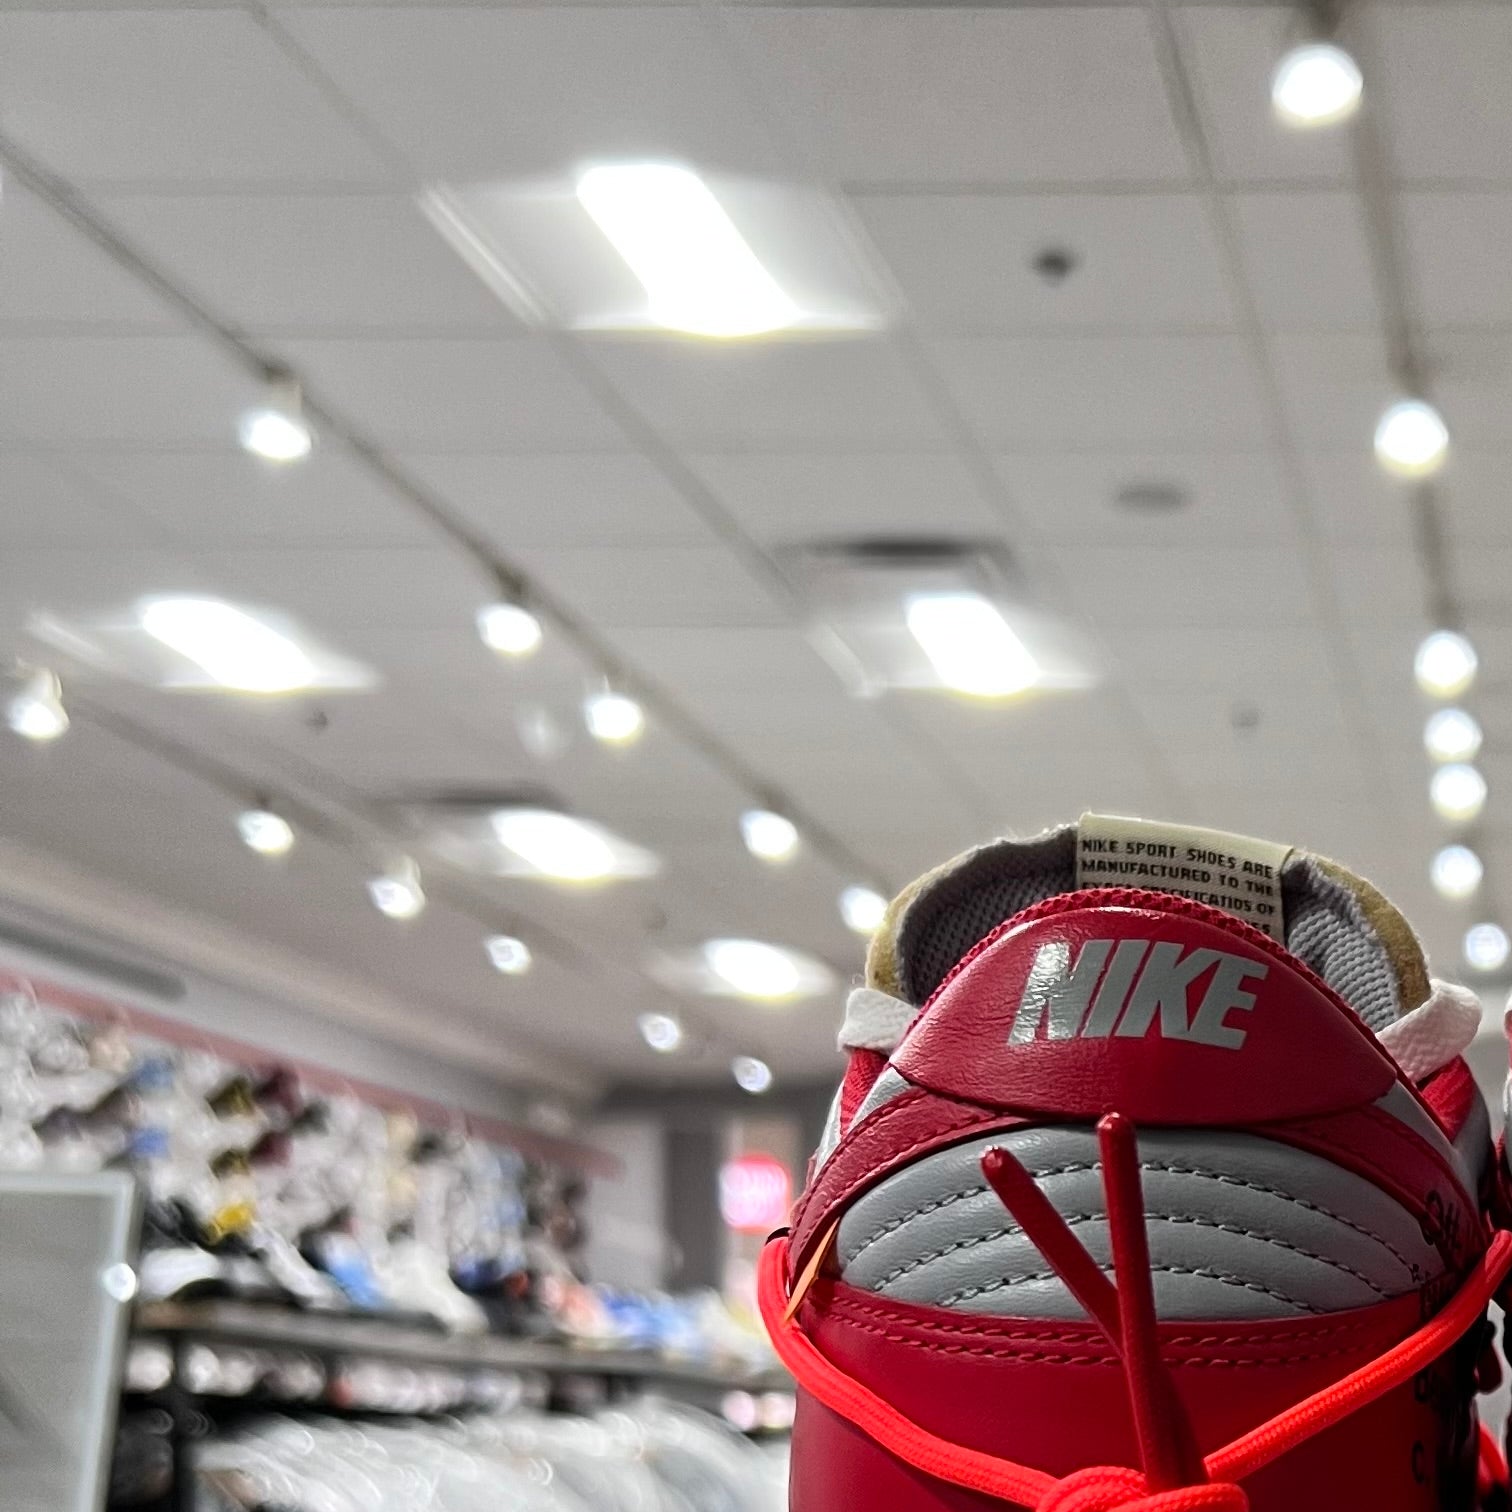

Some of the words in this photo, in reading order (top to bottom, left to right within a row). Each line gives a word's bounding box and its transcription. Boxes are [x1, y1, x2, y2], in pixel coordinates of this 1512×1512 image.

[1081, 839, 1118, 854] NIKE
[1126, 842, 1177, 859] SPORT
[1187, 847, 1237, 870] SHOES
[1242, 858, 1274, 880] ARE
[1081, 859, 1212, 884] MANUFACTURED
[1219, 873, 1239, 889] TO
[1244, 880, 1274, 898] THE
[1007, 938, 1269, 1050] NIKE
